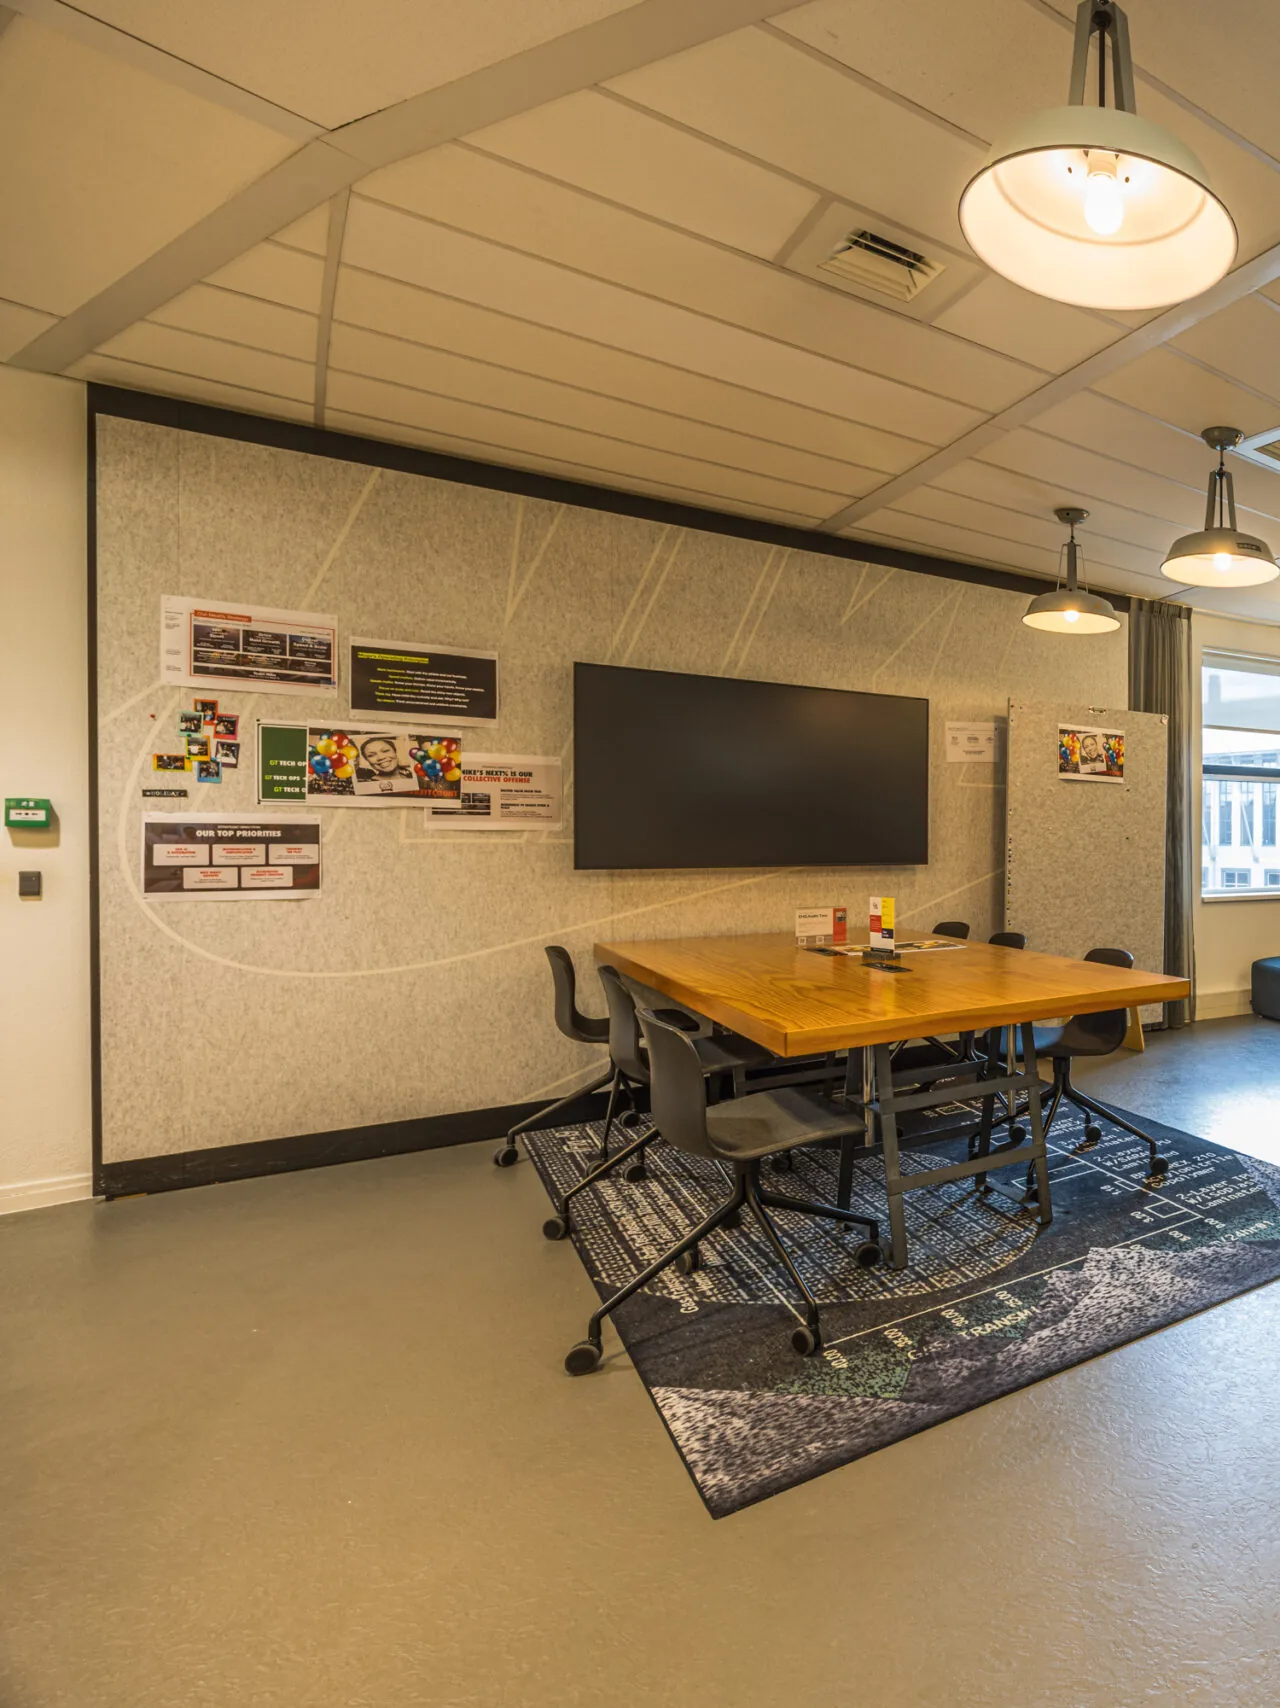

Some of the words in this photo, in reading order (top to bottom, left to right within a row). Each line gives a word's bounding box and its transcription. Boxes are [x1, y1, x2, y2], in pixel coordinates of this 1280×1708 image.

[236, 830, 282, 838] PRIORITIES
[1176, 1179, 1228, 1200] 2-Layer
[994, 1290, 1023, 1308] 25.00
[884, 1328, 913, 1348] 35.00
[823, 1349, 849, 1369] 40.00
